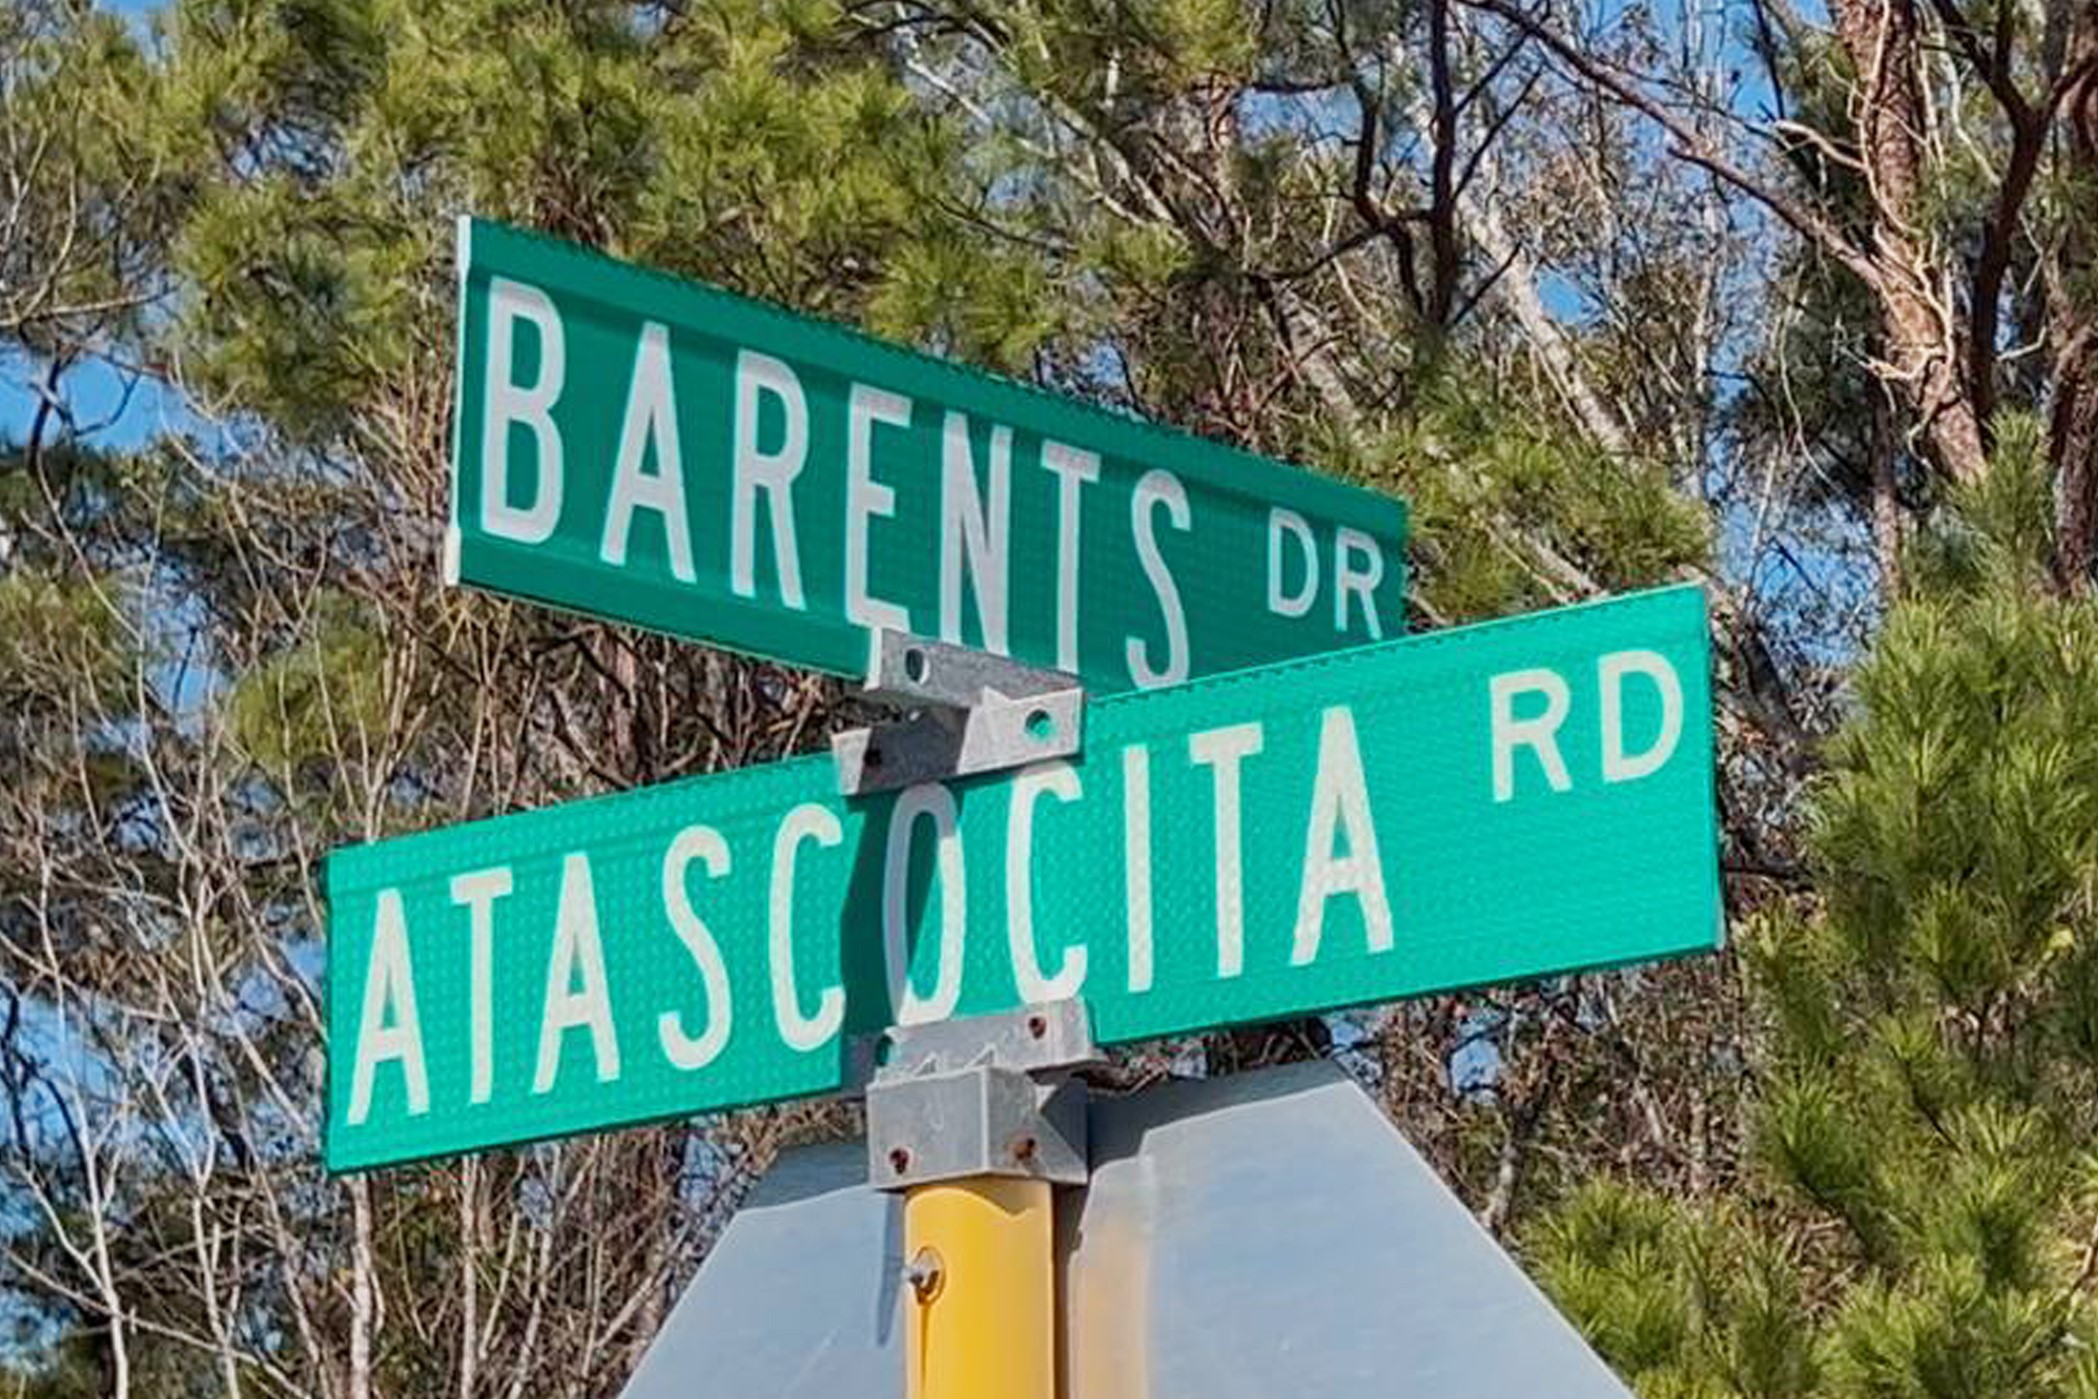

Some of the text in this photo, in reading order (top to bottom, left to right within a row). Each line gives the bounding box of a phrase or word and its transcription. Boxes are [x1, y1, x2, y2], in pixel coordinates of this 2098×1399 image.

[480, 275, 1386, 690] BARENTS DR
[347, 649, 1684, 1125] ATASCOCITA RD
